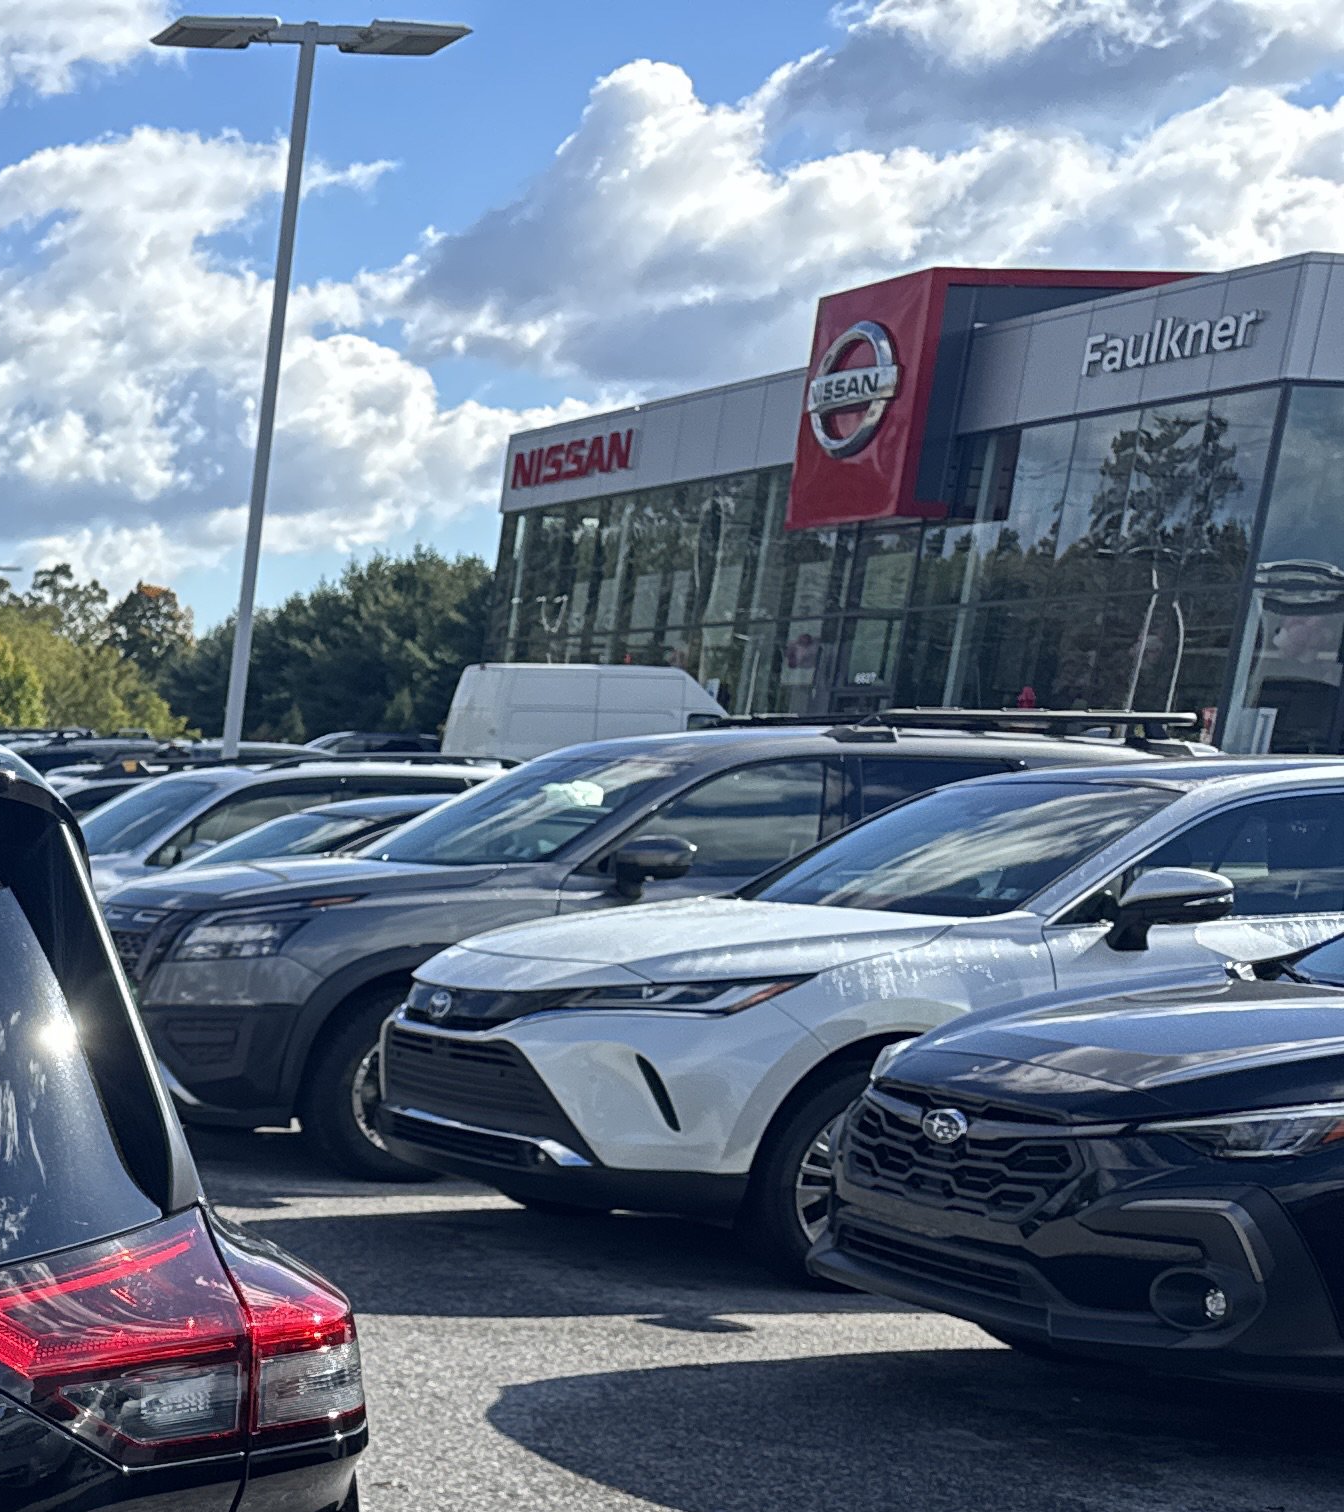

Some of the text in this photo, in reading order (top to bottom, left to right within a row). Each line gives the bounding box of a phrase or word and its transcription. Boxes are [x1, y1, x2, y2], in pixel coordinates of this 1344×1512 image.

[1081, 309, 1259, 377] Faulkner
[812, 373, 880, 403] NISSAN
[511, 428, 634, 490] NISSAN
